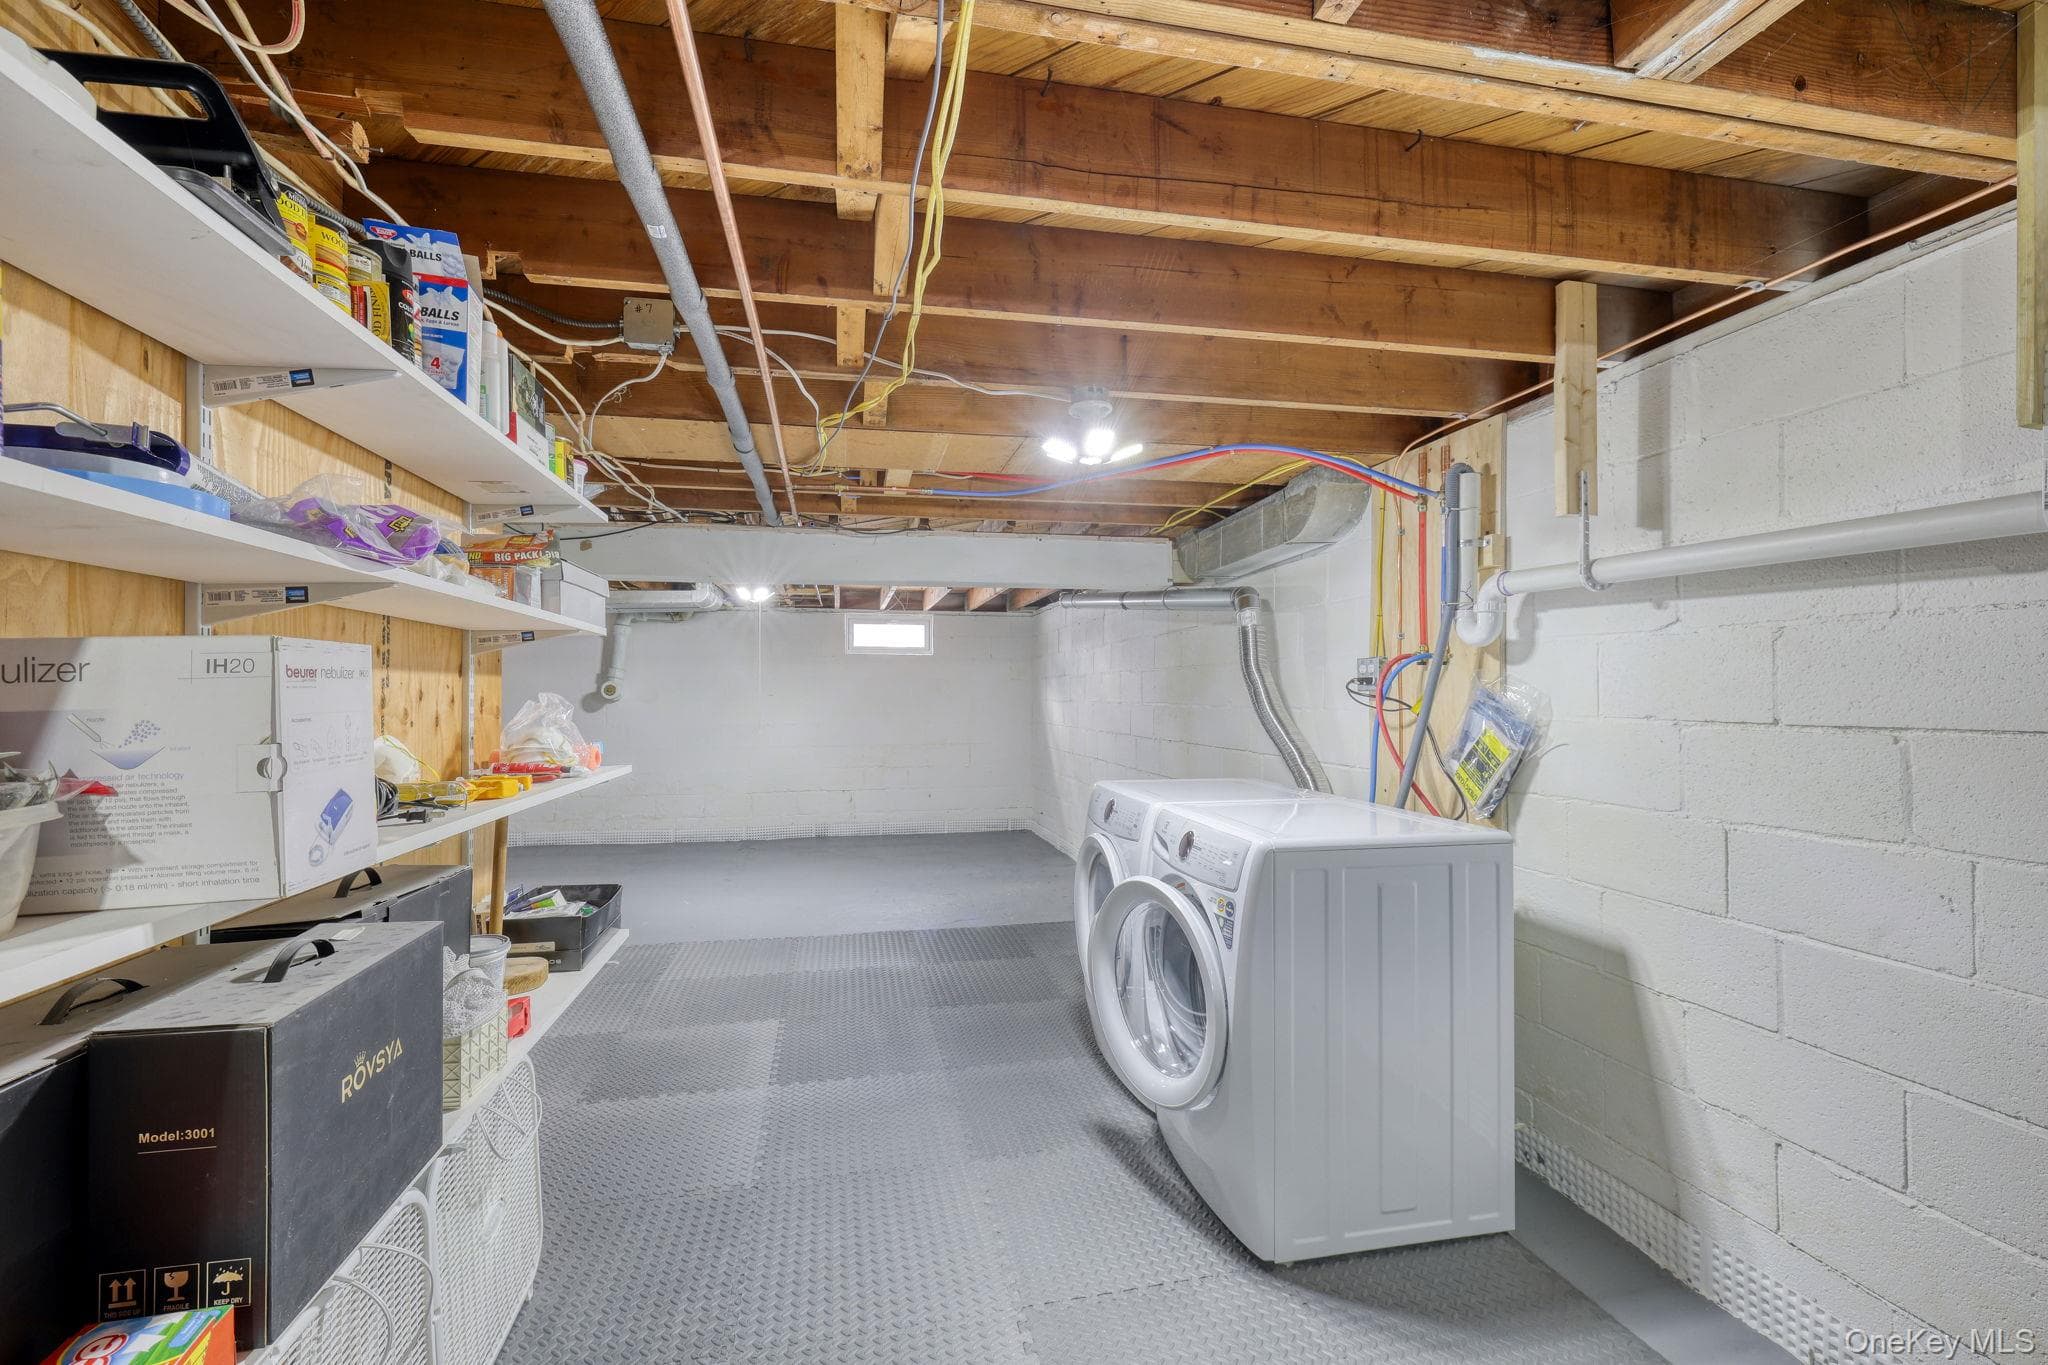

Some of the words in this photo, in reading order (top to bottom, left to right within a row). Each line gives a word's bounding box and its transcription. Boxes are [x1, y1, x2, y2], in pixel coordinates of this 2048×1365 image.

[410, 249, 442, 261] BALLS
[420, 306, 460, 321] BALLS
[431, 356, 441, 370] 4
[494, 552, 512, 562] BIG
[0, 656, 91, 684] ulizer
[206, 657, 256, 674] IH20
[285, 664, 318, 679] beurer
[320, 666, 355, 680] nebulizer
[201, 877, 241, 887] inhalation
[242, 876, 260, 884] time
[341, 1036, 403, 1105] ROVSYA
[138, 1127, 215, 1144] Model:3001
[163, 1302, 191, 1311] FRAGILE
[213, 1298, 230, 1306] KEEP
